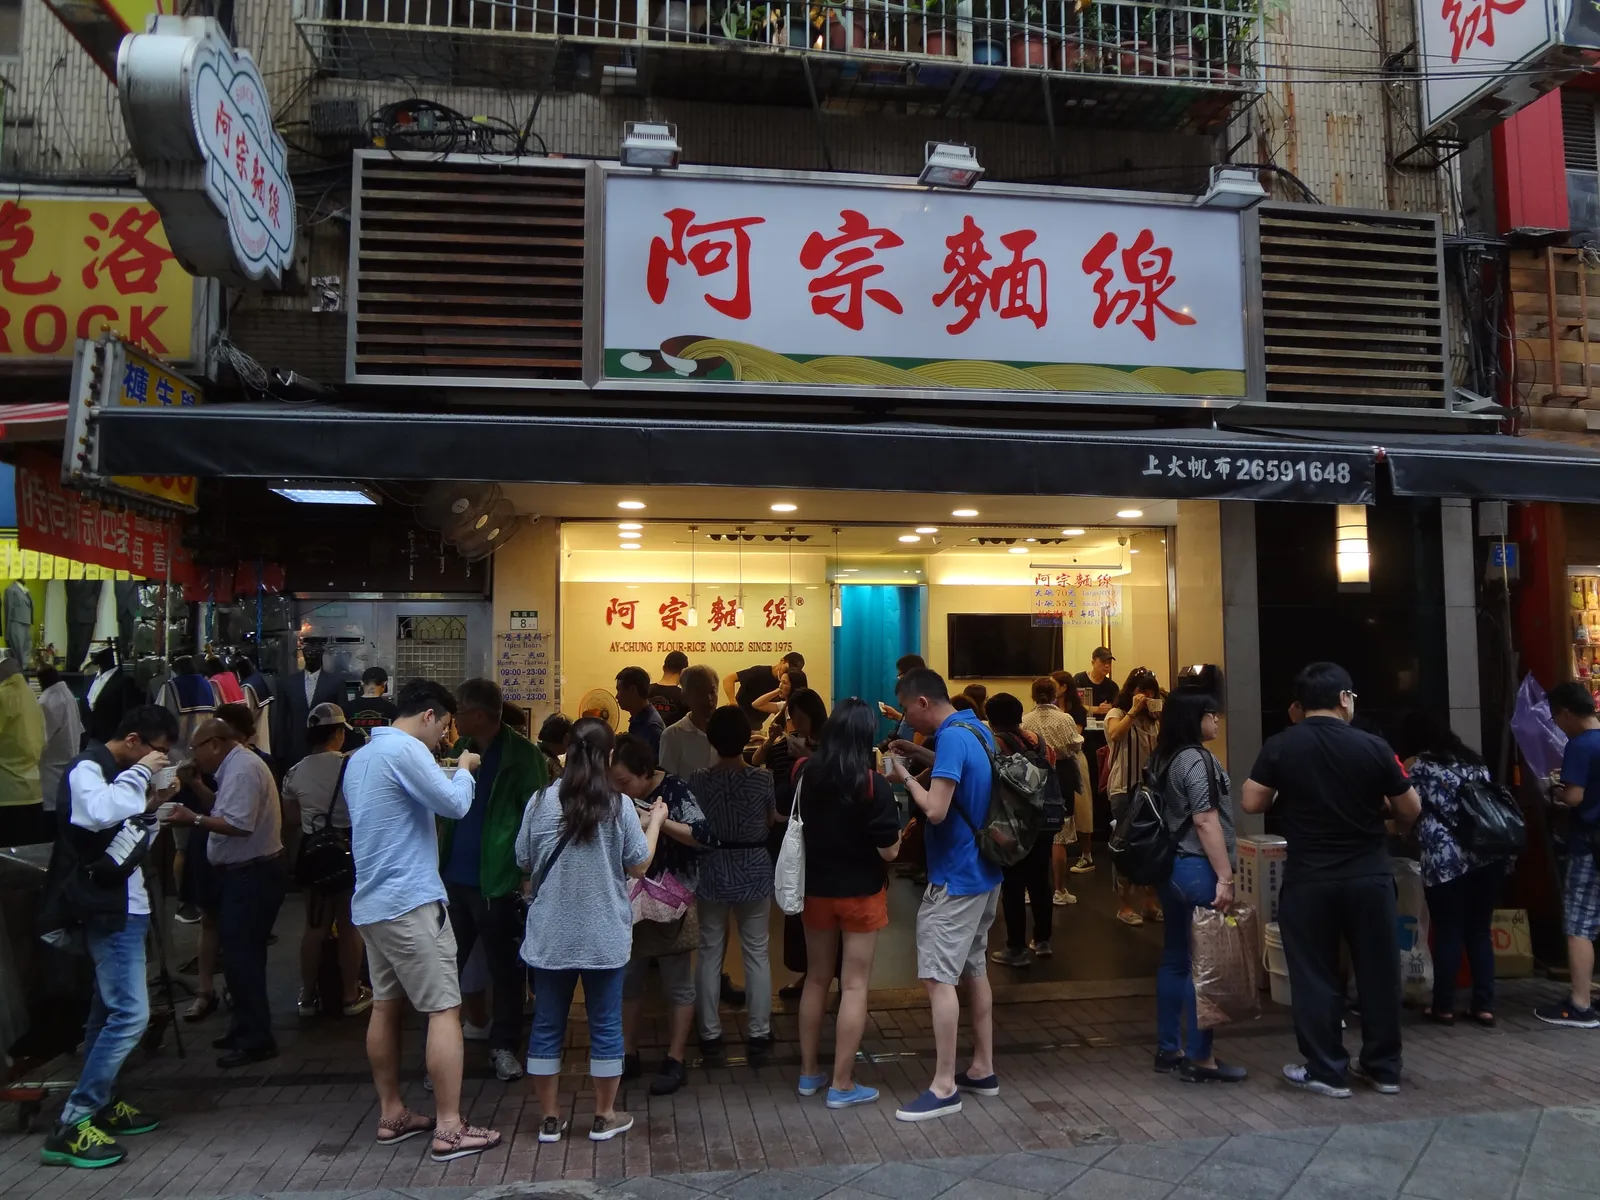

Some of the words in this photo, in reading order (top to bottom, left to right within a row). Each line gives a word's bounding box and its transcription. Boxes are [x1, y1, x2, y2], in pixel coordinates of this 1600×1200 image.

[215, 100, 281, 230] 阿宗麵線
[645, 207, 1197, 342] 阿宗麵線
[1035, 573, 1114, 588] 阿宗麵線
[606, 595, 797, 631] 阿宗麵線
[504, 641, 521, 650] Open
[522, 641, 542, 649] Hours
[609, 641, 653, 653] AY-CHUNG
[656, 641, 706, 653] FLOUR-RICE
[710, 641, 744, 653] NOODLE
[748, 641, 772, 653] SINCE
[774, 641, 793, 653] 1975
